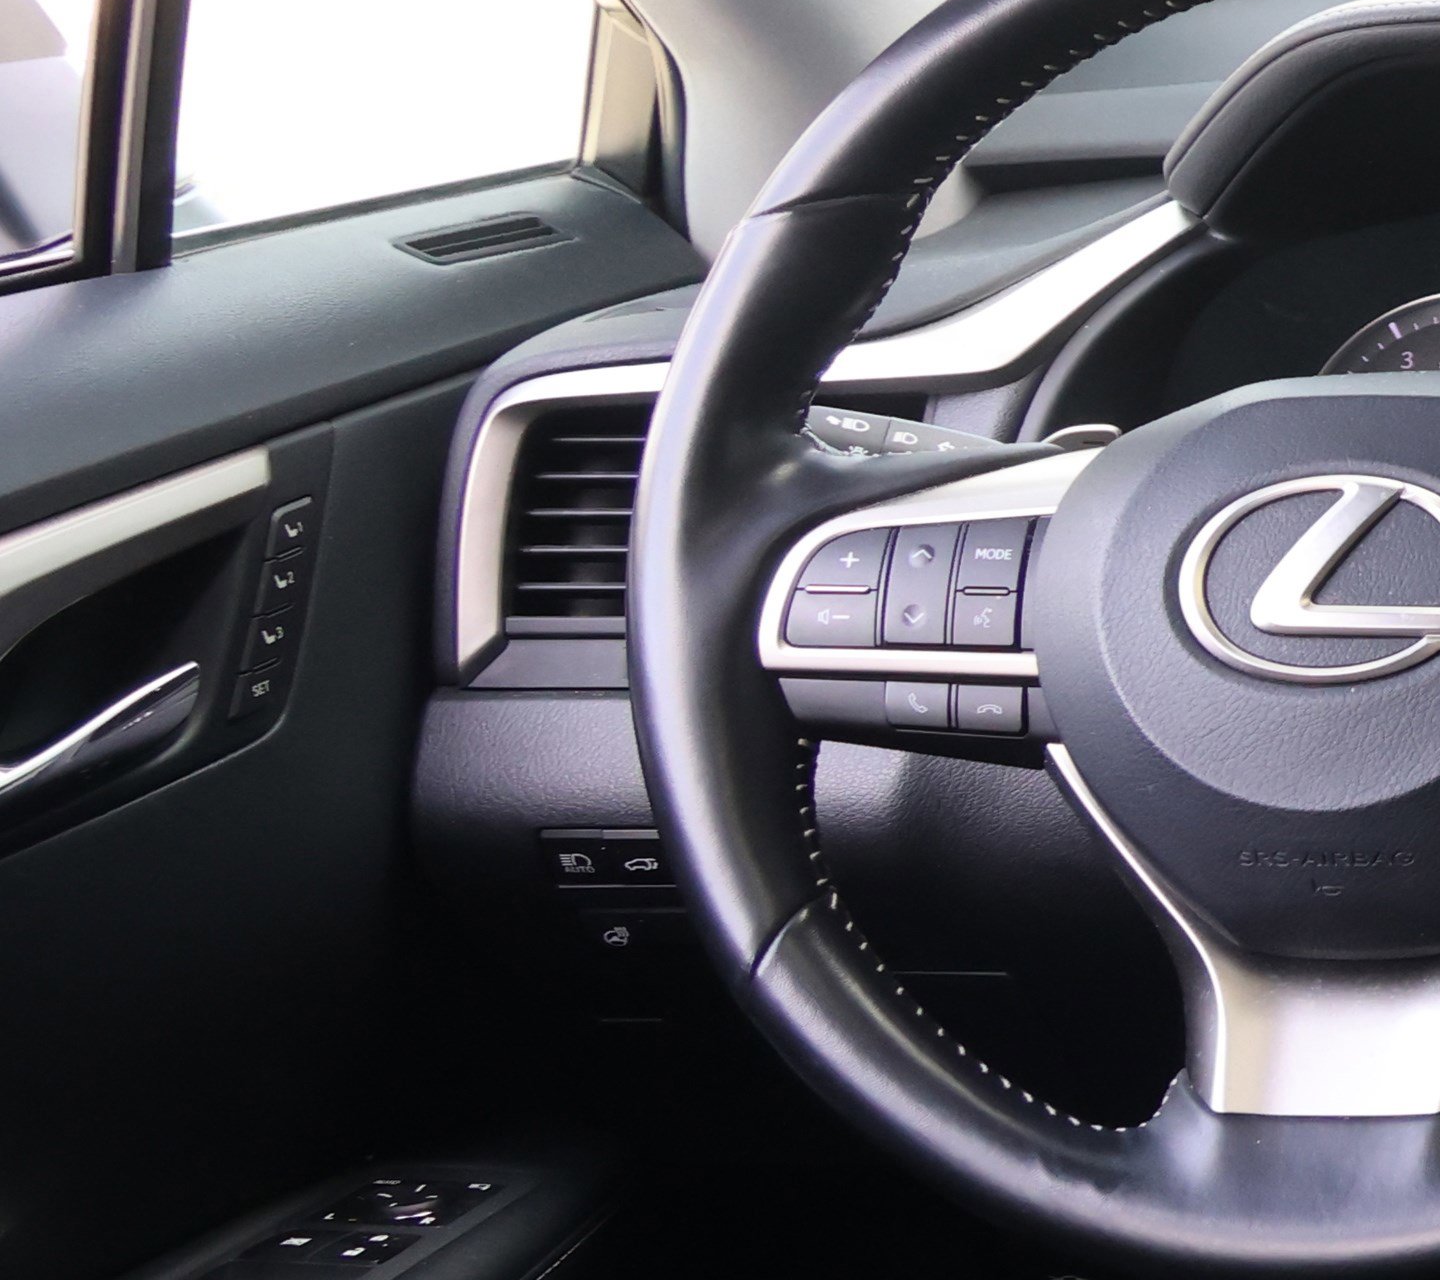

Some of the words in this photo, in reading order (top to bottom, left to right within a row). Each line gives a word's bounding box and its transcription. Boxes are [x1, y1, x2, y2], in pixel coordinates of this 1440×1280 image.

[1400, 351, 1414, 370] 3
[974, 548, 1013, 560] MODE
[251, 679, 270, 697] SET
